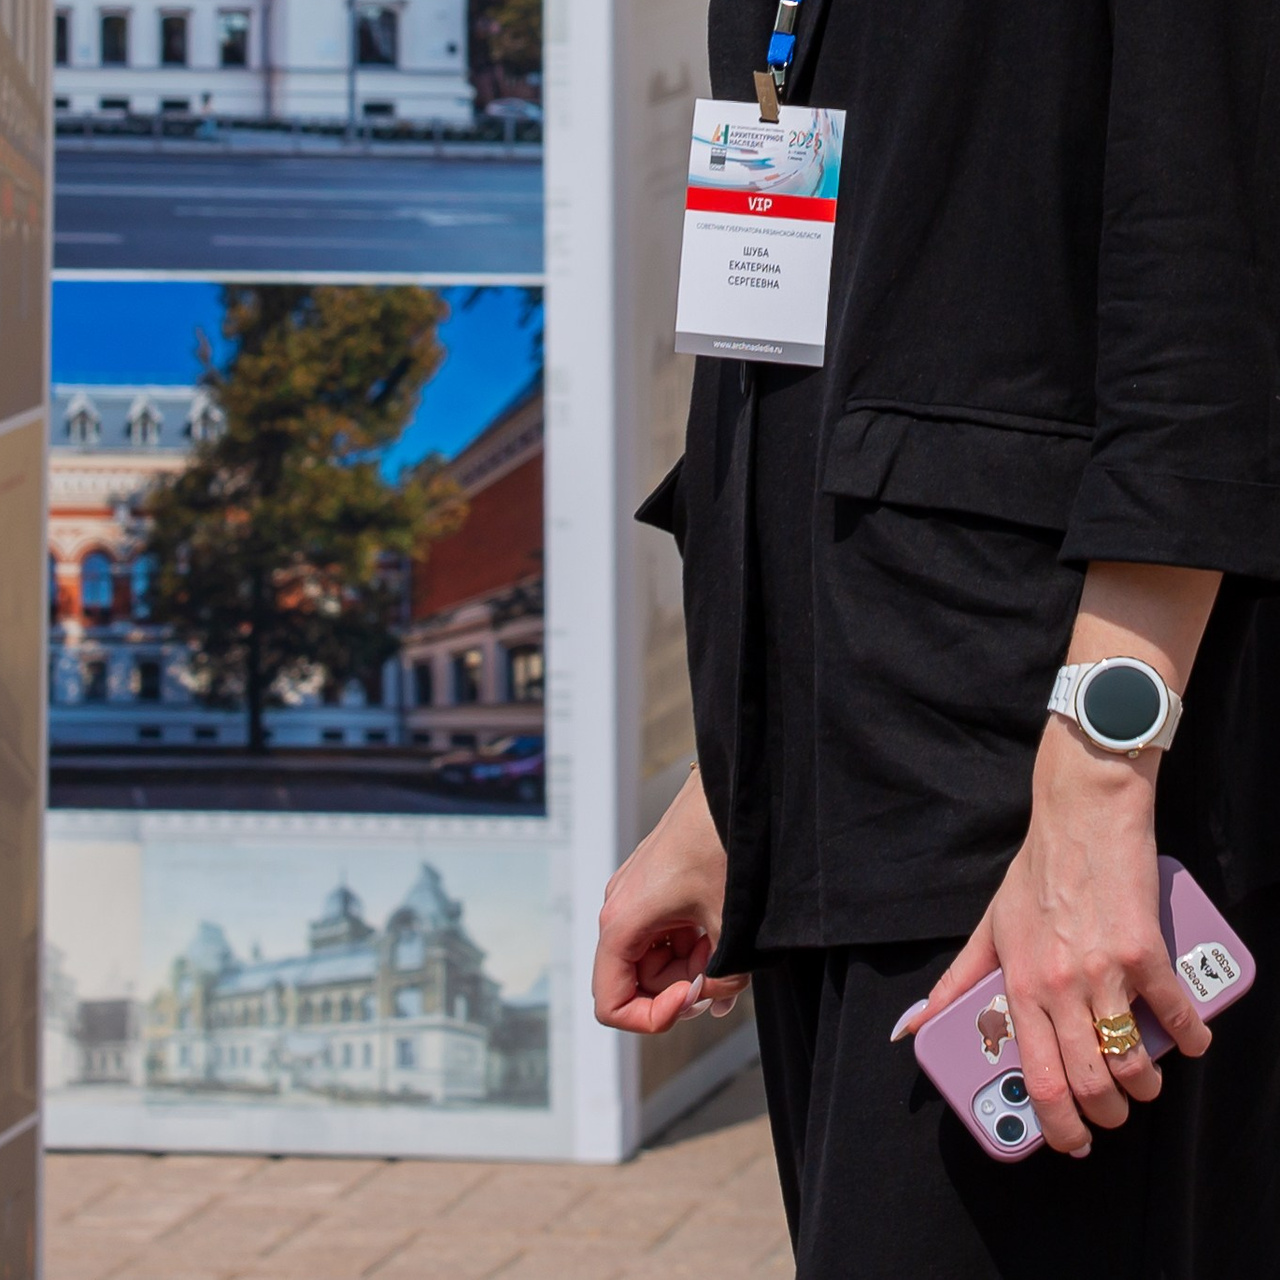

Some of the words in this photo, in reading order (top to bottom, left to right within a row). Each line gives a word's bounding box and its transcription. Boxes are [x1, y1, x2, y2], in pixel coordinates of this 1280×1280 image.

[730, 131, 784, 142] АРХИТЕКТУРНОЕ
[729, 139, 764, 148] НАСЛЕДИЕ
[747, 196, 773, 212] VIP
[743, 246, 770, 258] ШУБА
[729, 260, 781, 274] ЕКАТЕРИНА
[727, 275, 780, 289] СЕРГЕЕВНА
